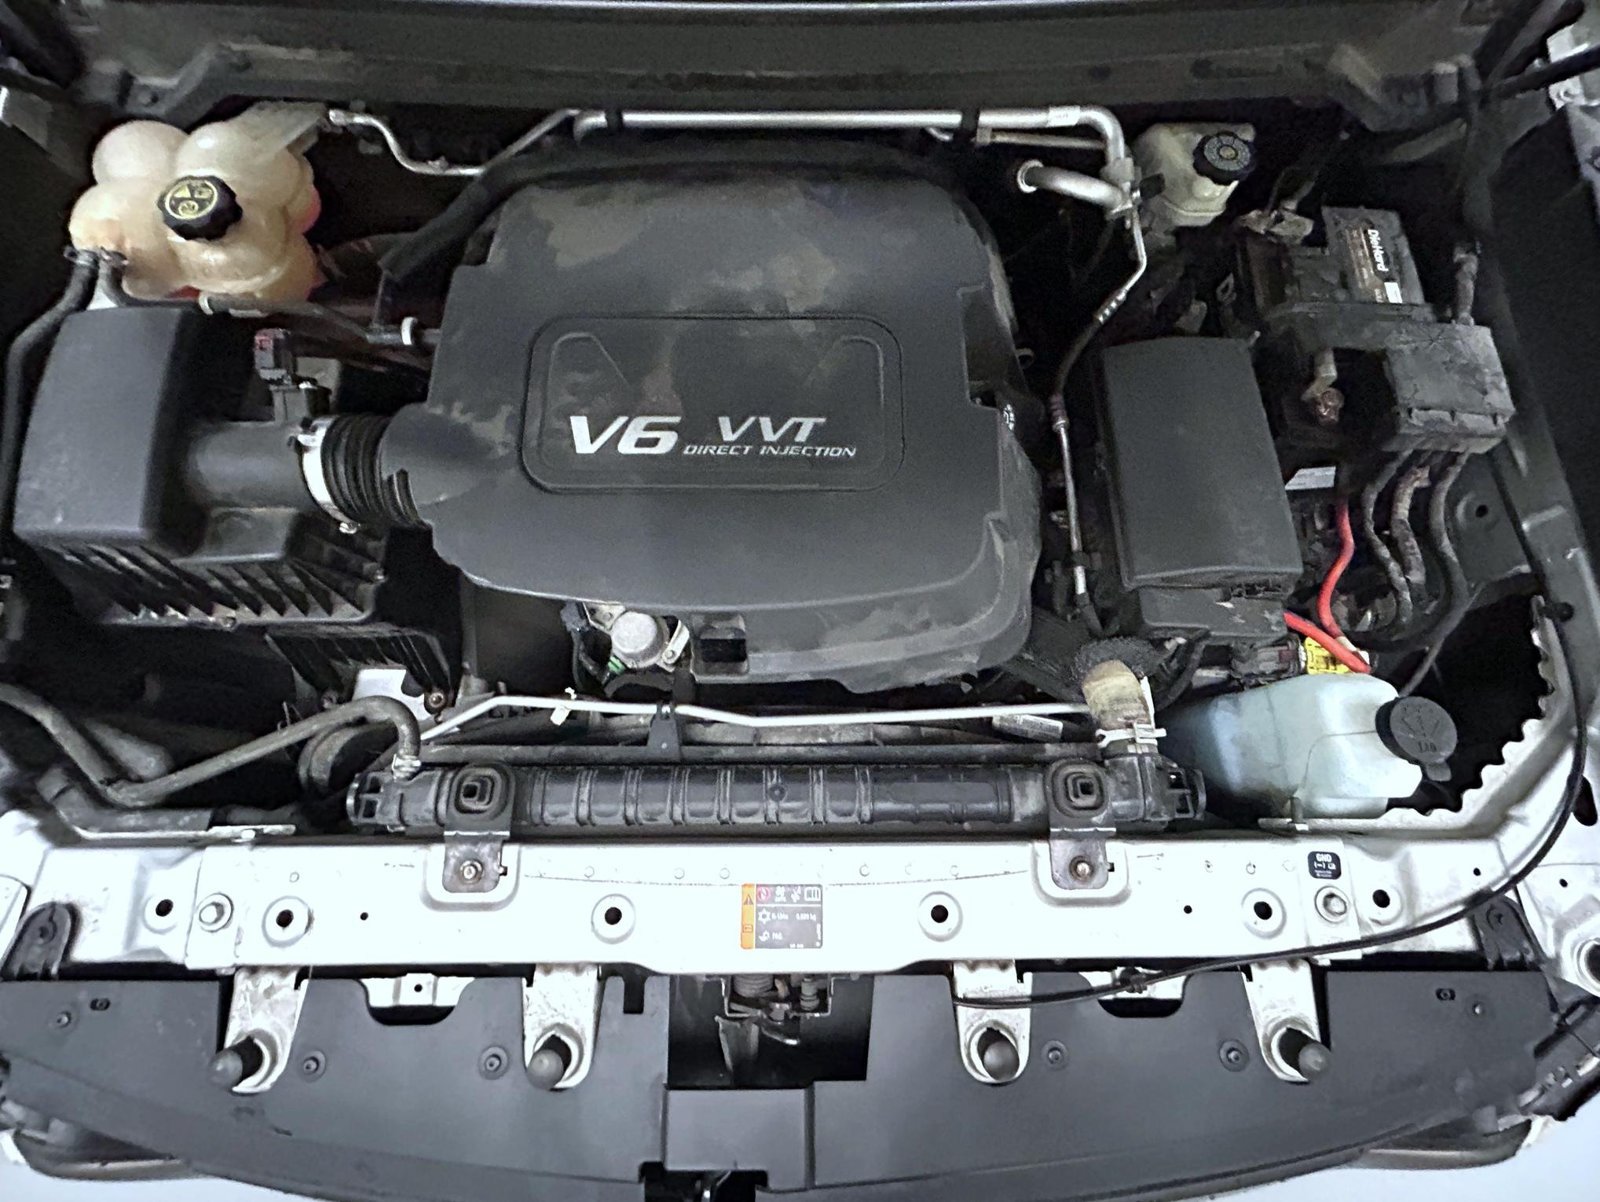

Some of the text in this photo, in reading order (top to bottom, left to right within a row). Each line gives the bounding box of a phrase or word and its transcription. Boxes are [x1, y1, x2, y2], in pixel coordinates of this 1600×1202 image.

[1368, 229, 1389, 272] DieHard
[569, 416, 682, 454] V6
[718, 416, 826, 442] VVT
[683, 445, 857, 457] DIRECT INJECTION
